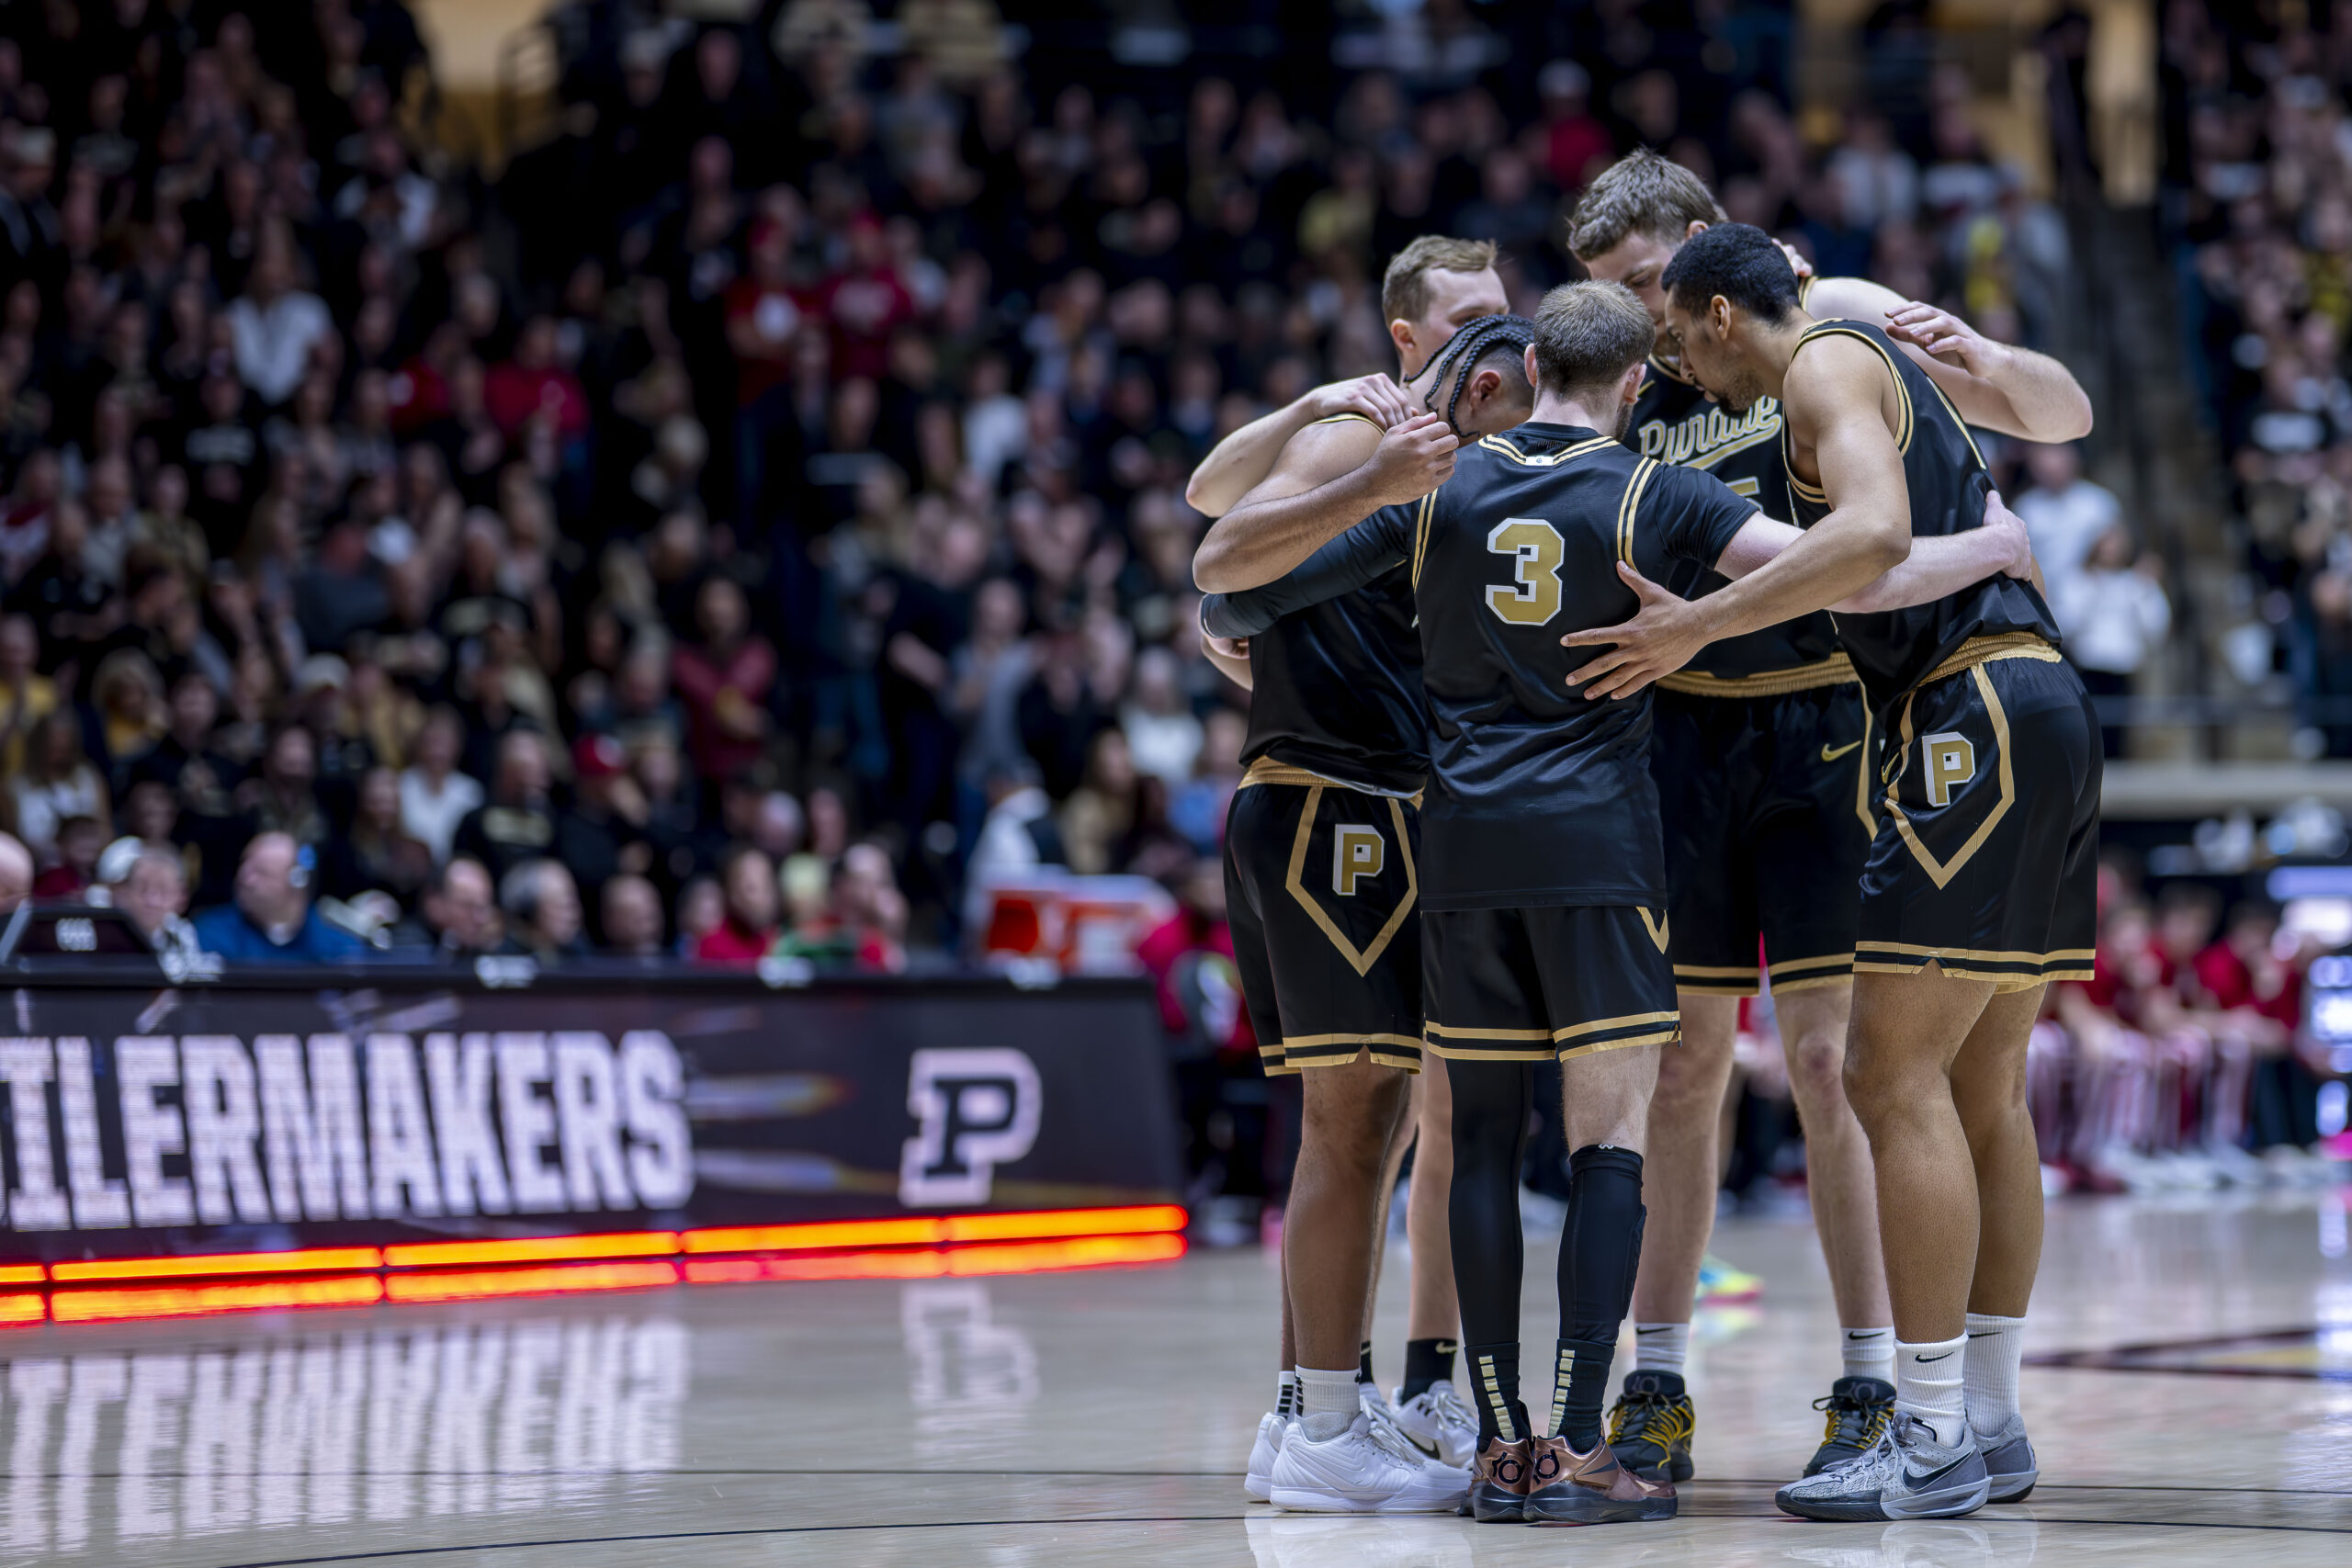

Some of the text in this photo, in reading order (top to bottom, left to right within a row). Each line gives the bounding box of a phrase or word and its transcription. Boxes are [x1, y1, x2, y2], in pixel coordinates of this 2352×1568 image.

[1485, 517, 1566, 626] 3
[1922, 731, 1976, 807] P
[1332, 823, 1385, 896] P
[0, 1031, 695, 1232] ILERMAKERS
[899, 1047, 1043, 1208] P
